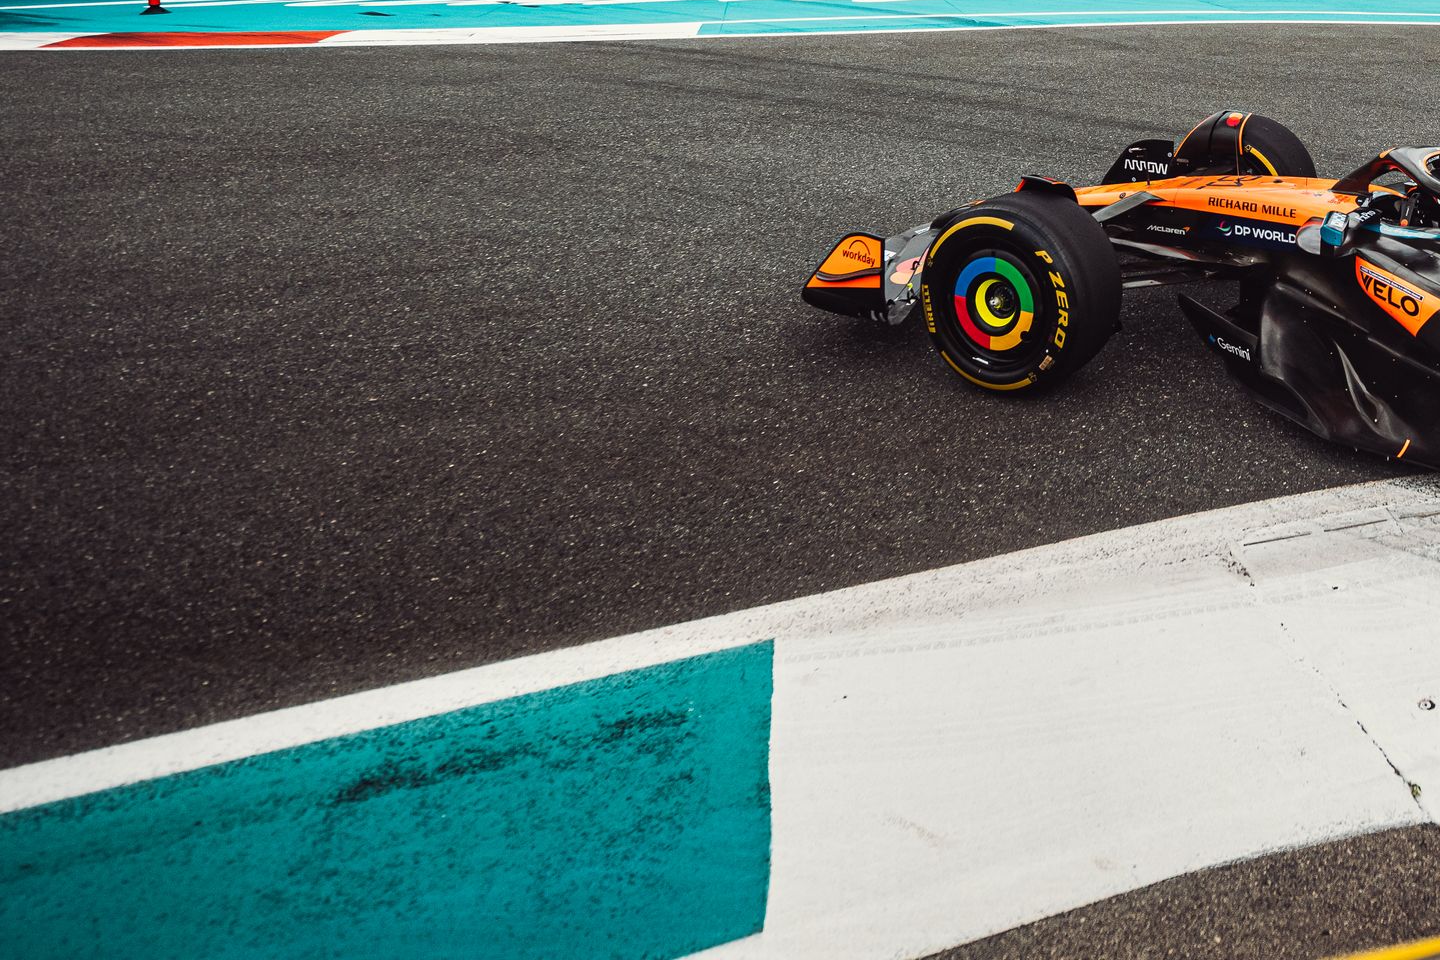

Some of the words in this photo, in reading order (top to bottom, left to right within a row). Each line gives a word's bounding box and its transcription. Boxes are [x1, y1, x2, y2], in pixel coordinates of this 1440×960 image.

[1208, 196, 1258, 213] RICHARD
[1261, 204, 1297, 219] MILLE
[1146, 224, 1187, 236] McLaren
[1234, 224, 1251, 237] DP
[1252, 227, 1297, 244] WORLD
[842, 248, 876, 268] workday
[1034, 250, 1054, 264] P
[1048, 271, 1070, 350] ZERO
[1360, 271, 1420, 317] VELO
[1217, 337, 1251, 362] Gemini
